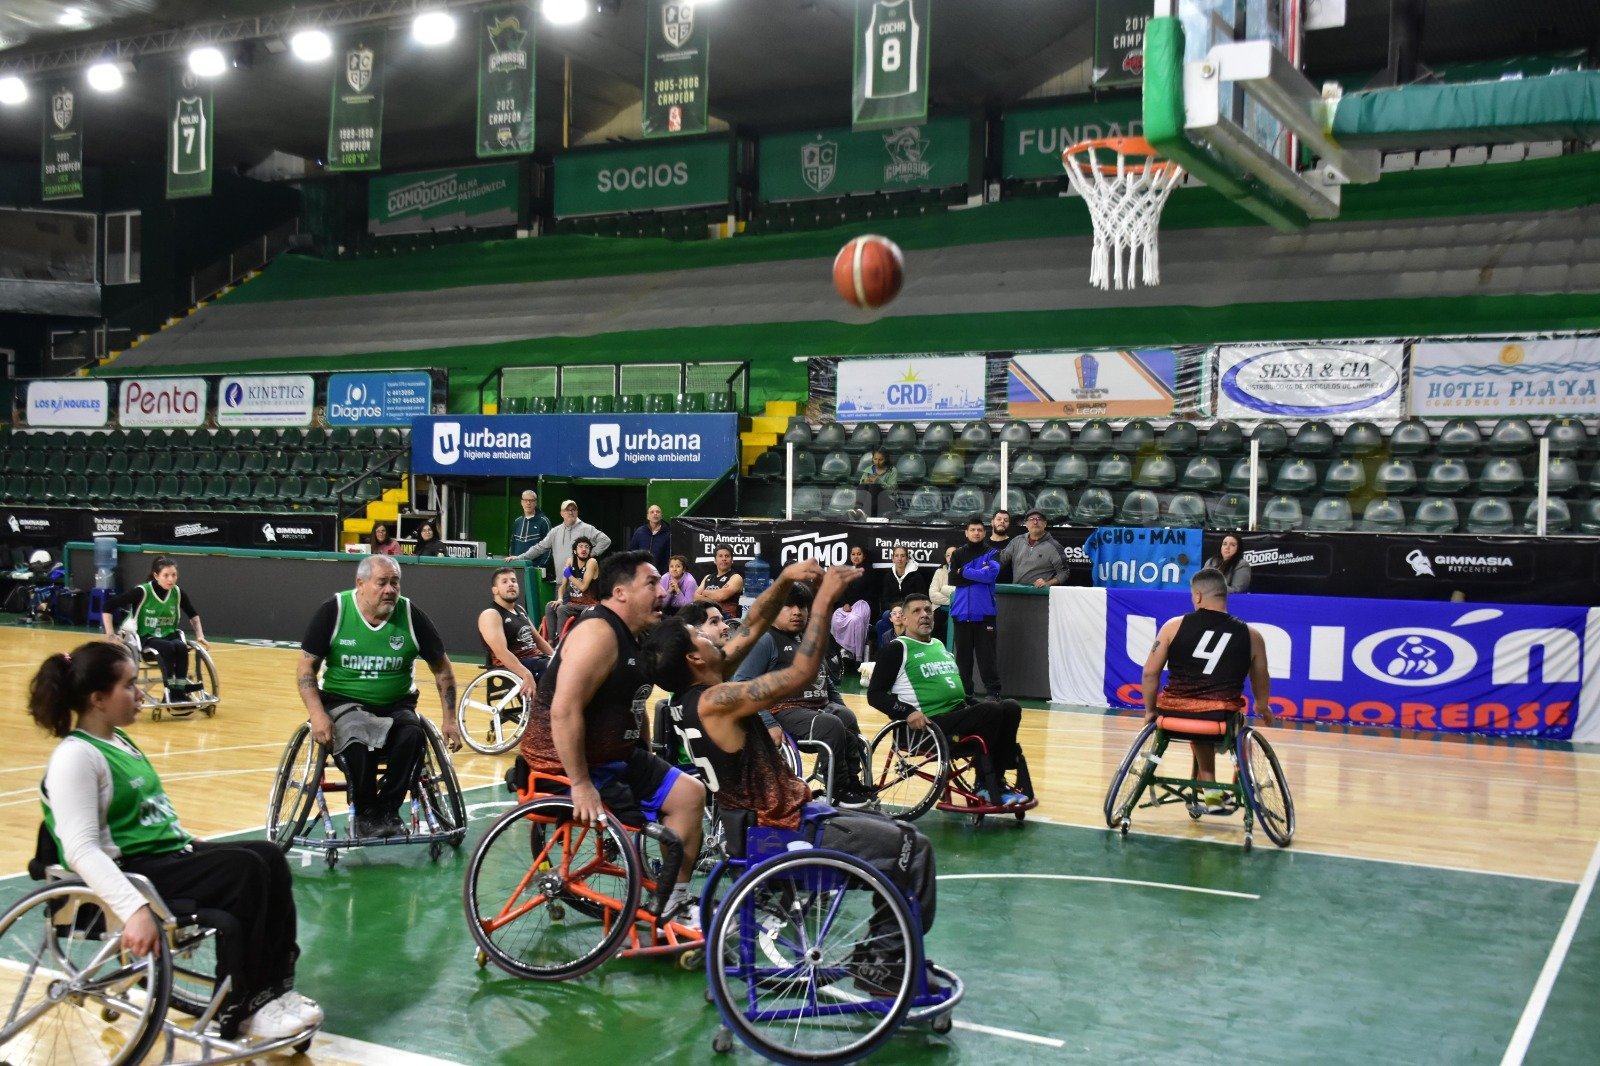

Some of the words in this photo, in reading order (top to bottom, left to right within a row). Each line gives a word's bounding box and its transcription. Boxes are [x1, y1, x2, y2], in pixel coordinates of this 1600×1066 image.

[1113, 32, 1144, 49] CAMP
[881, 37, 901, 72] 8
[183, 127, 195, 154] 7
[458, 178, 478, 191] ALMA
[597, 161, 688, 193] SOCIOS
[388, 179, 457, 212] COMODORO
[1259, 363, 1313, 379] SESSA
[1319, 363, 1334, 378] &
[1339, 362, 1370, 378] CIA
[248, 385, 305, 399] KINETICS
[887, 383, 928, 405] CRD
[1427, 381, 1499, 398] HOTEL
[1509, 379, 1596, 397] PLAYA
[34, 400, 50, 409] LOS
[126, 382, 198, 414] Penta
[331, 403, 382, 421] Diagnos
[464, 428, 531, 448] urbana
[624, 429, 701, 450] urbana
[464, 450, 490, 460] higiene
[492, 450, 531, 460] ambiental
[624, 452, 655, 463] higiene
[657, 452, 701, 462] ambiental
[699, 533, 714, 542] Pan
[715, 533, 755, 543] American
[875, 538, 892, 547] Pan
[893, 538, 939, 549] American
[1150, 530, 1186, 545] MAN
[446, 546, 471, 558] ODORO
[704, 543, 750, 555] ENGY
[780, 541, 848, 567] COMO
[1243, 551, 1279, 564] ODORO
[1434, 555, 1513, 566] GIMNASIA
[1191, 630, 1233, 675] 4
[341, 654, 403, 671] COMERCIO
[944, 677, 956, 688] 5
